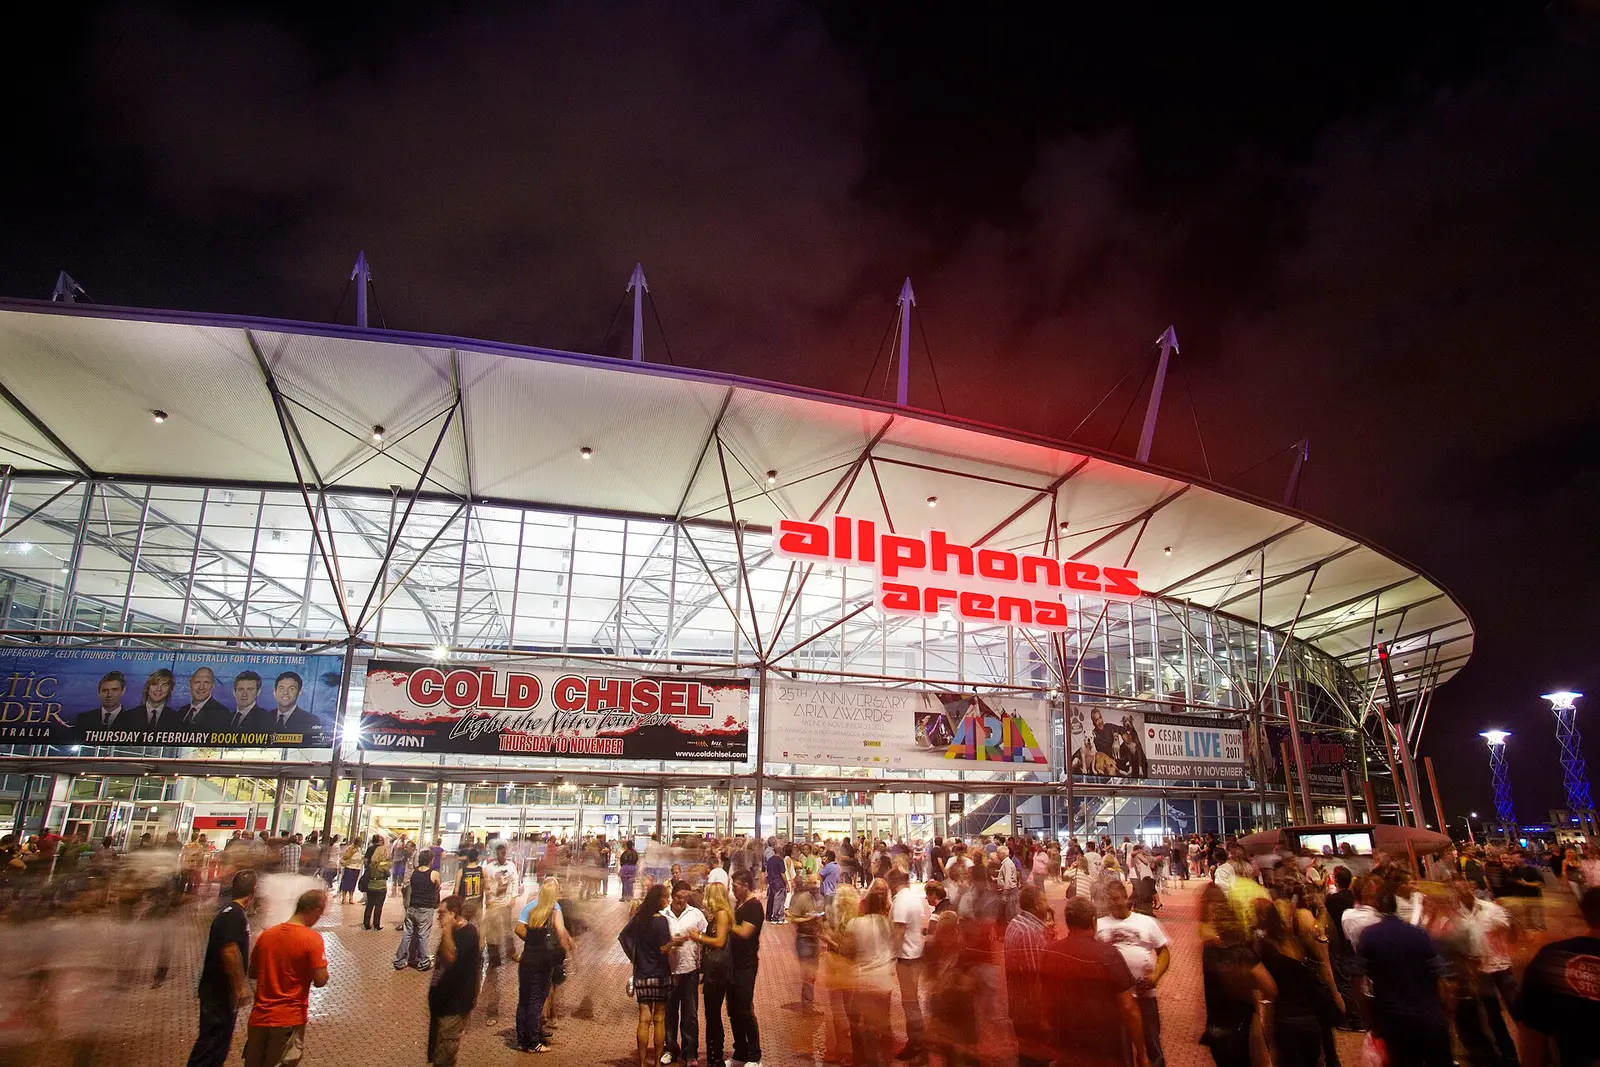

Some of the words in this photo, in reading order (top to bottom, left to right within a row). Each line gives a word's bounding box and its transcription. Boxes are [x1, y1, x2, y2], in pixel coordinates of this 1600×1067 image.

[779, 514, 1141, 597] allphones
[882, 582, 1068, 627] arena
[55, 650, 80, 659] CELTIC
[80, 650, 116, 660] THUNDER
[121, 652, 133, 660] ON
[134, 652, 154, 660] TOUR
[158, 653, 175, 661] LIVE
[176, 653, 185, 661] IN
[186, 654, 228, 663] AUSTRALIA
[230, 655, 245, 663] FOR
[246, 655, 261, 664] THE
[261, 656, 284, 664] FIRST
[284, 656, 305, 665] TIME!
[406, 667, 543, 711] COLD
[550, 673, 715, 719] CHISEL
[779, 686, 808, 701] 25TH
[811, 690, 909, 709] ANNIVERSARY
[793, 703, 829, 719] ARIA
[832, 706, 893, 723] AWARDS
[449, 709, 511, 740] Light
[510, 711, 544, 732] the
[538, 709, 598, 737] Nitro
[85, 730, 140, 743] THURSDAY
[142, 731, 154, 743] 16
[155, 731, 209, 744] FEBRUARY
[210, 732, 239, 744] BOOK
[240, 733, 268, 745] NOW!
[499, 734, 552, 752] THURSDAY
[555, 737, 567, 753] 10
[570, 738, 624, 755] NOVEMBER
[1158, 729, 1182, 742] CESAR
[1184, 730, 1221, 758] LIVE
[1224, 733, 1242, 745] TOUR
[1155, 743, 1183, 757] MILLAN
[1225, 746, 1240, 759] 2011
[1151, 764, 1191, 776] SATURDAY
[1193, 766, 1202, 776] 19
[1203, 766, 1243, 777] NOVEMBER
[465, 873, 480, 896] 11
